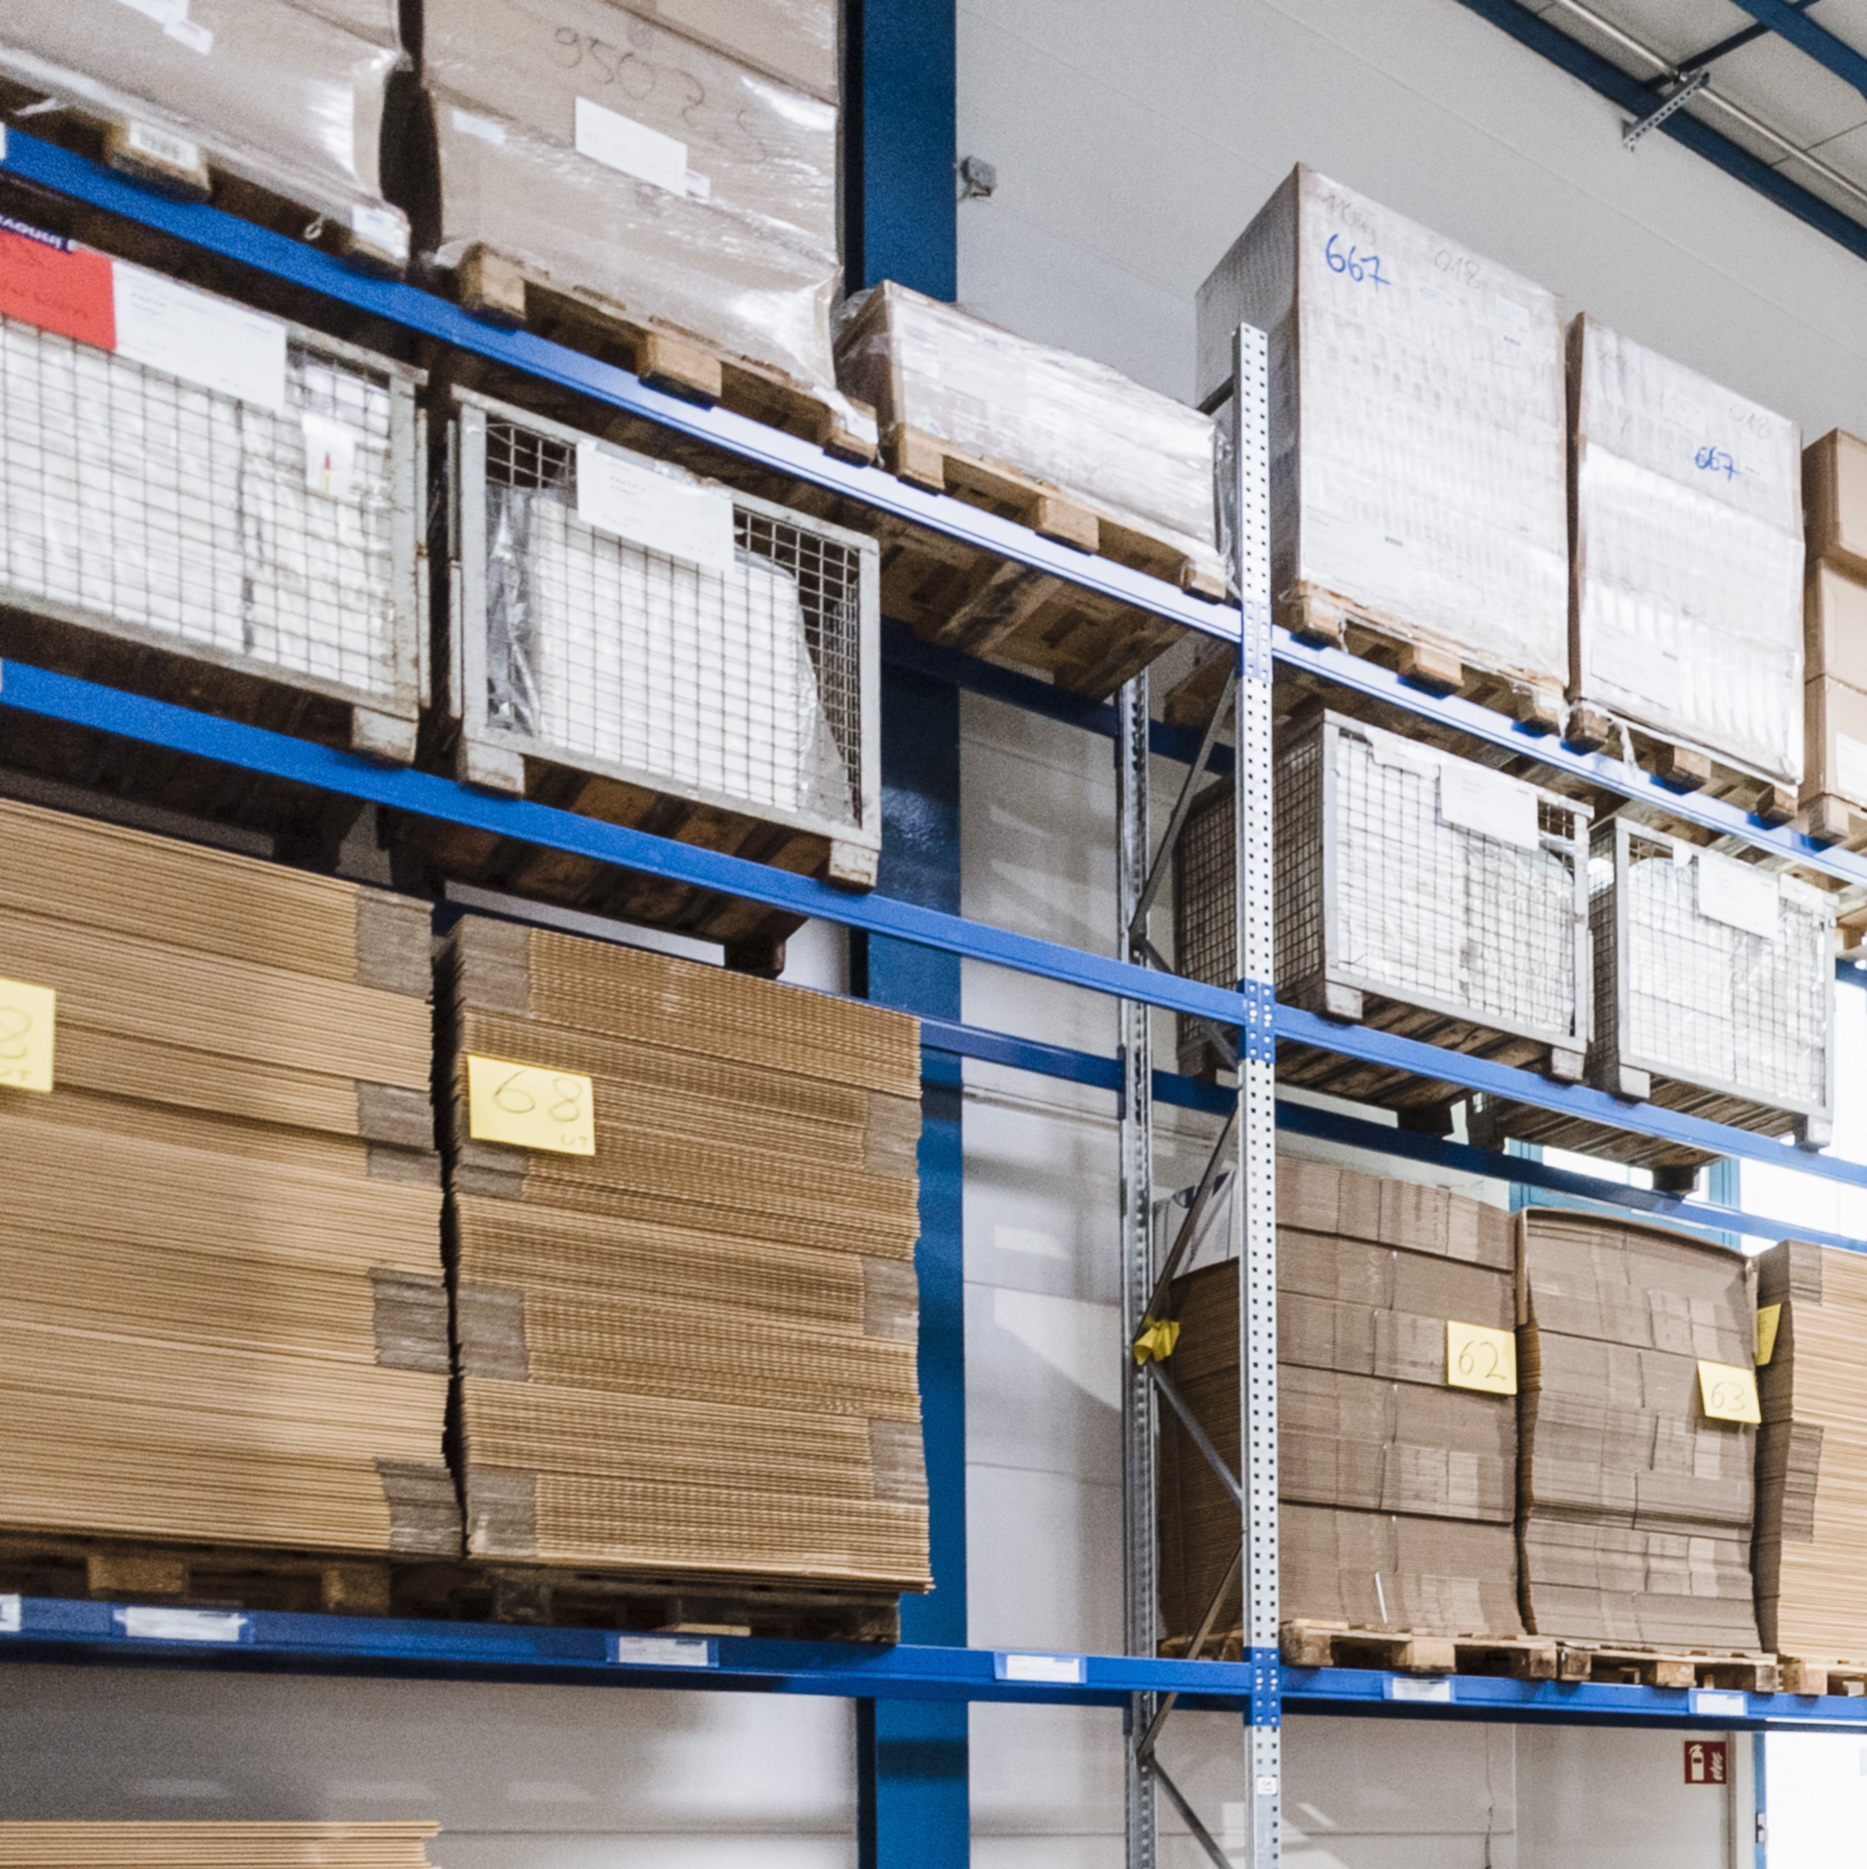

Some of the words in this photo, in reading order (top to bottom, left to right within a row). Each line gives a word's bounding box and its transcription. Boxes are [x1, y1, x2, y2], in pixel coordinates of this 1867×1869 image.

[1325, 233, 1391, 292] 667
[1694, 446, 1741, 481] 667
[491, 1068, 583, 1123] 68
[1458, 1339, 1507, 1381] 62
[1710, 1380, 1747, 1412] 63
